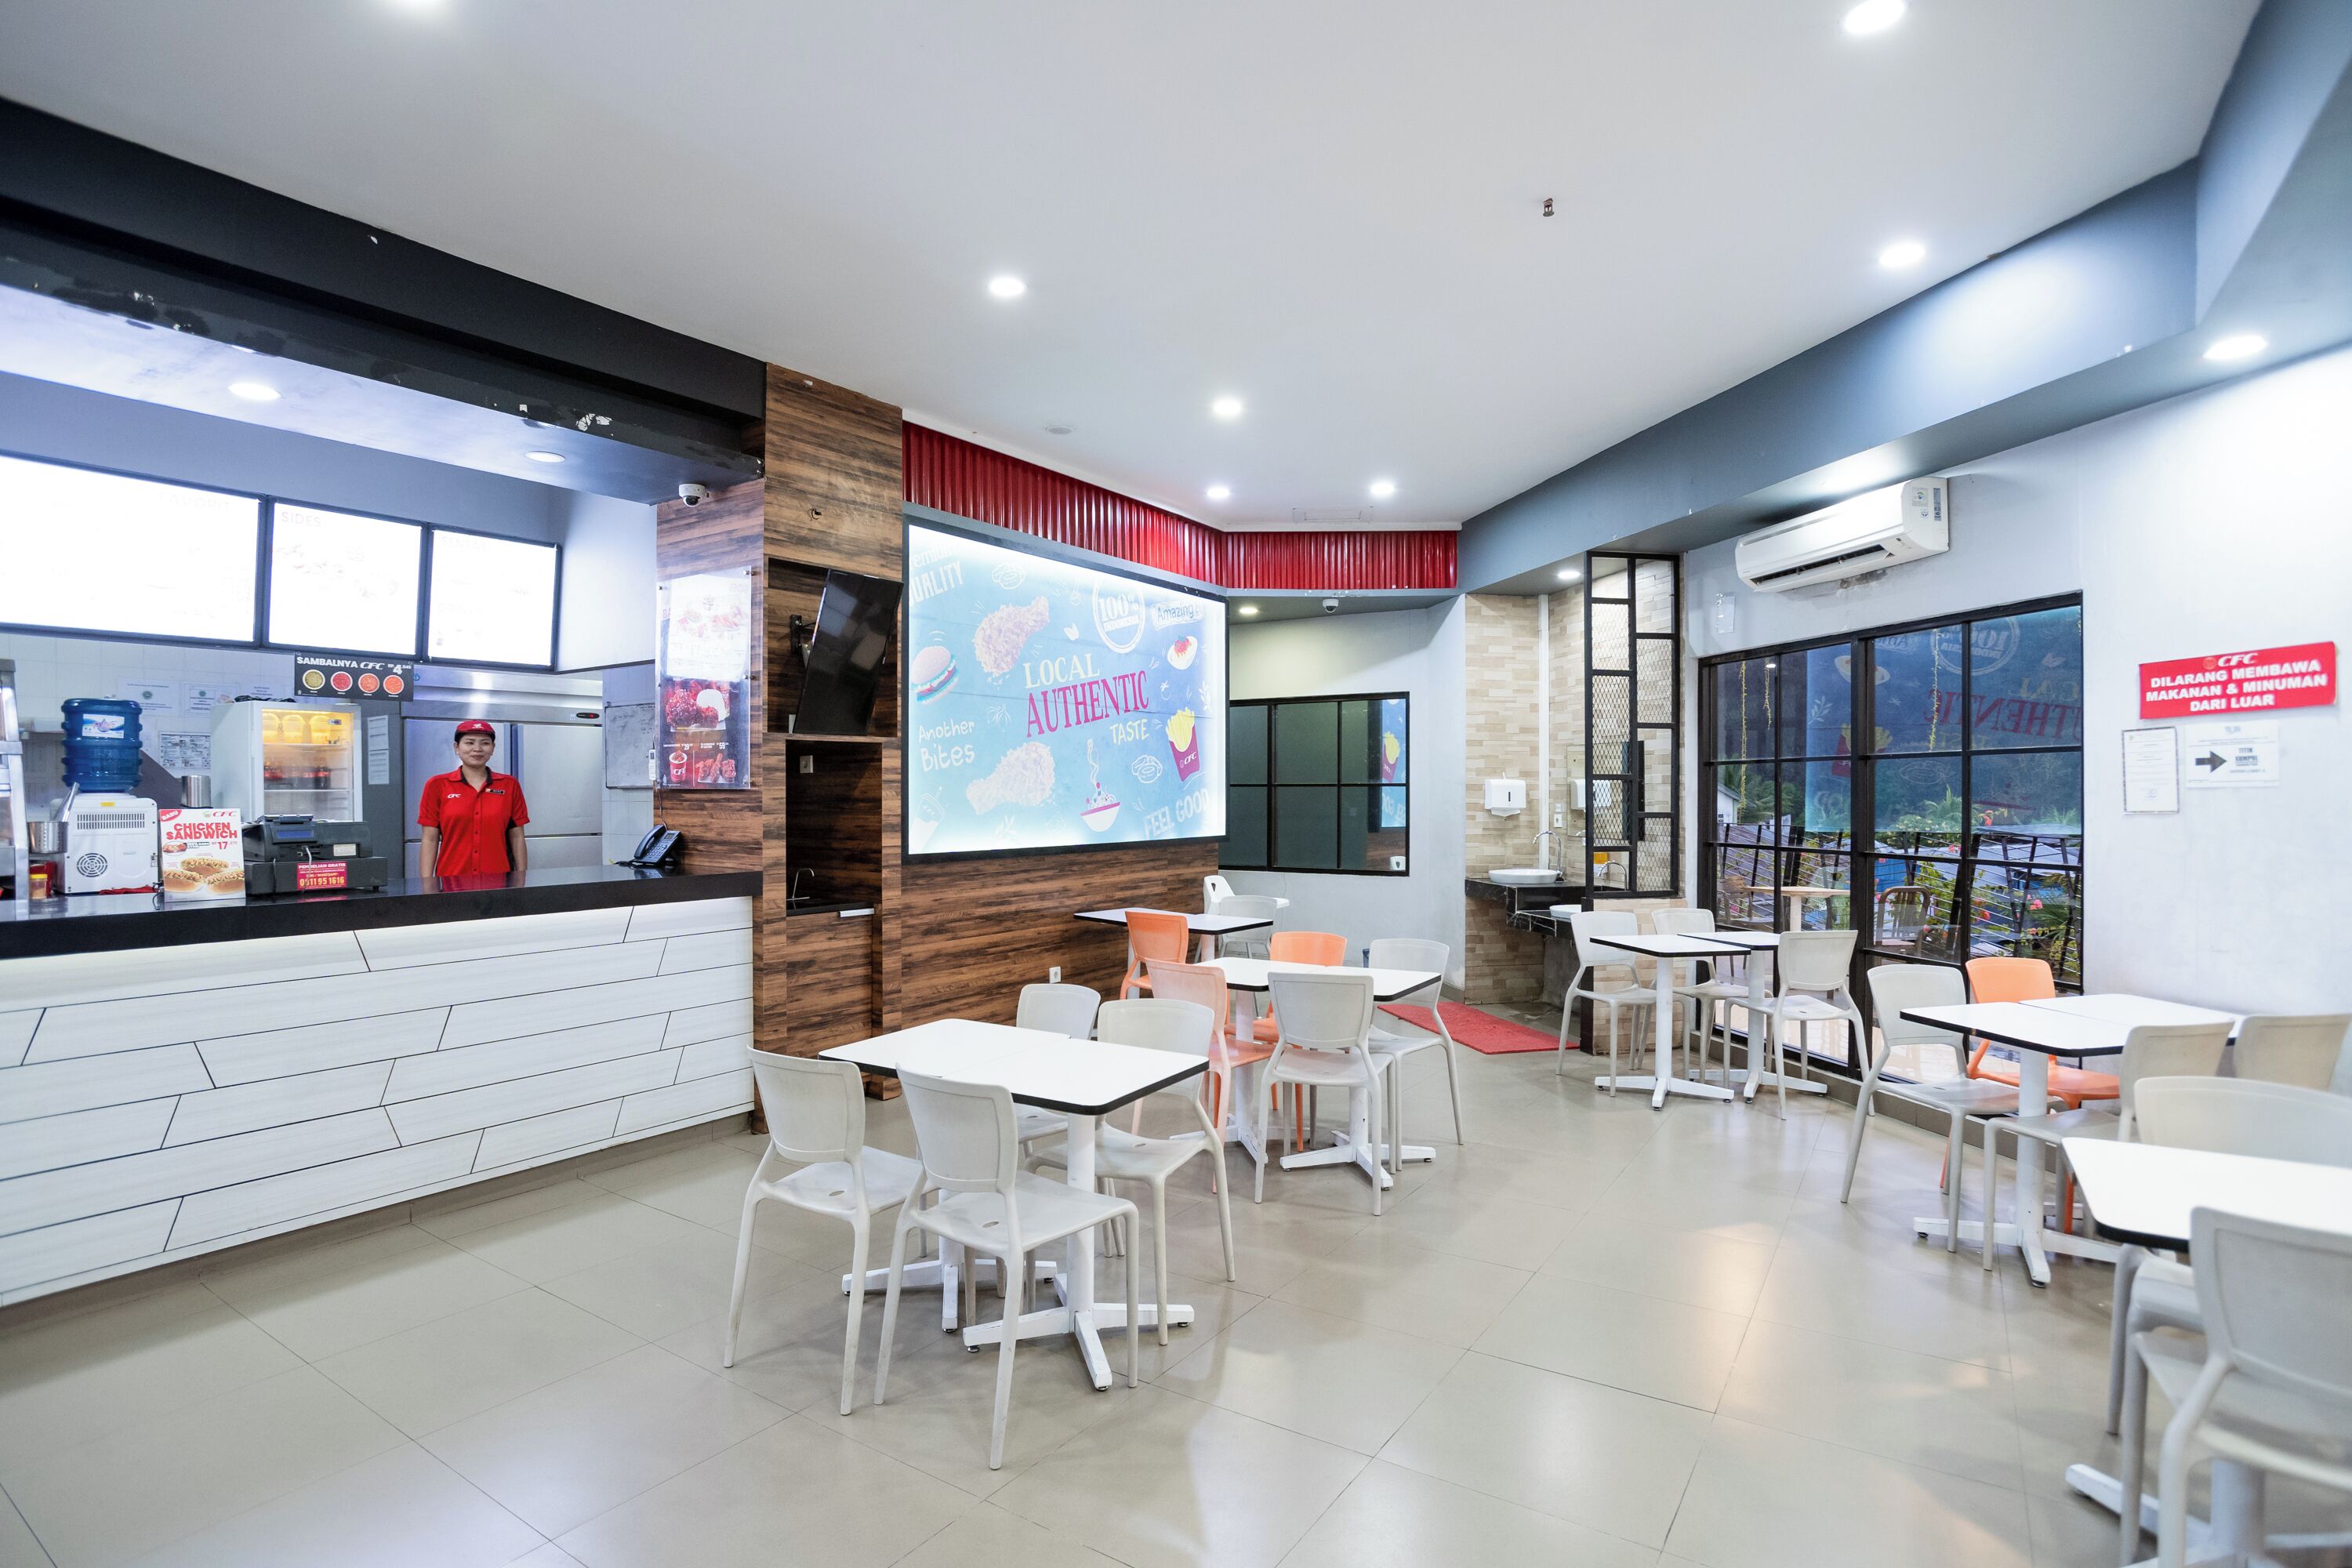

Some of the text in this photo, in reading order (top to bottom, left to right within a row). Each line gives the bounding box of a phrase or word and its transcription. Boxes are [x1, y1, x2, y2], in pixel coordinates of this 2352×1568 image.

[281, 511, 321, 528] SIDES
[1098, 593, 1139, 622] 100%
[296, 656, 358, 668] SAMBALNYA
[360, 662, 385, 670] CFC
[1022, 653, 1100, 689] LOCAL
[2218, 652, 2258, 666] CFC
[2151, 659, 2322, 688] DILARANG MEMBAWA
[2146, 674, 2328, 702] MAKANAN & MINUMAN
[1026, 670, 1149, 738] AUTHENTIC
[2190, 694, 2274, 712] DARI LUAR
[918, 717, 975, 743] Another
[1109, 719, 1150, 746] TASTE
[920, 743, 975, 772] Bites
[162, 811, 179, 821] BARU
[173, 822, 230, 832] CHICKEN
[1143, 788, 1209, 840] FEEL GOOD
[165, 830, 238, 840] SANDWICH
